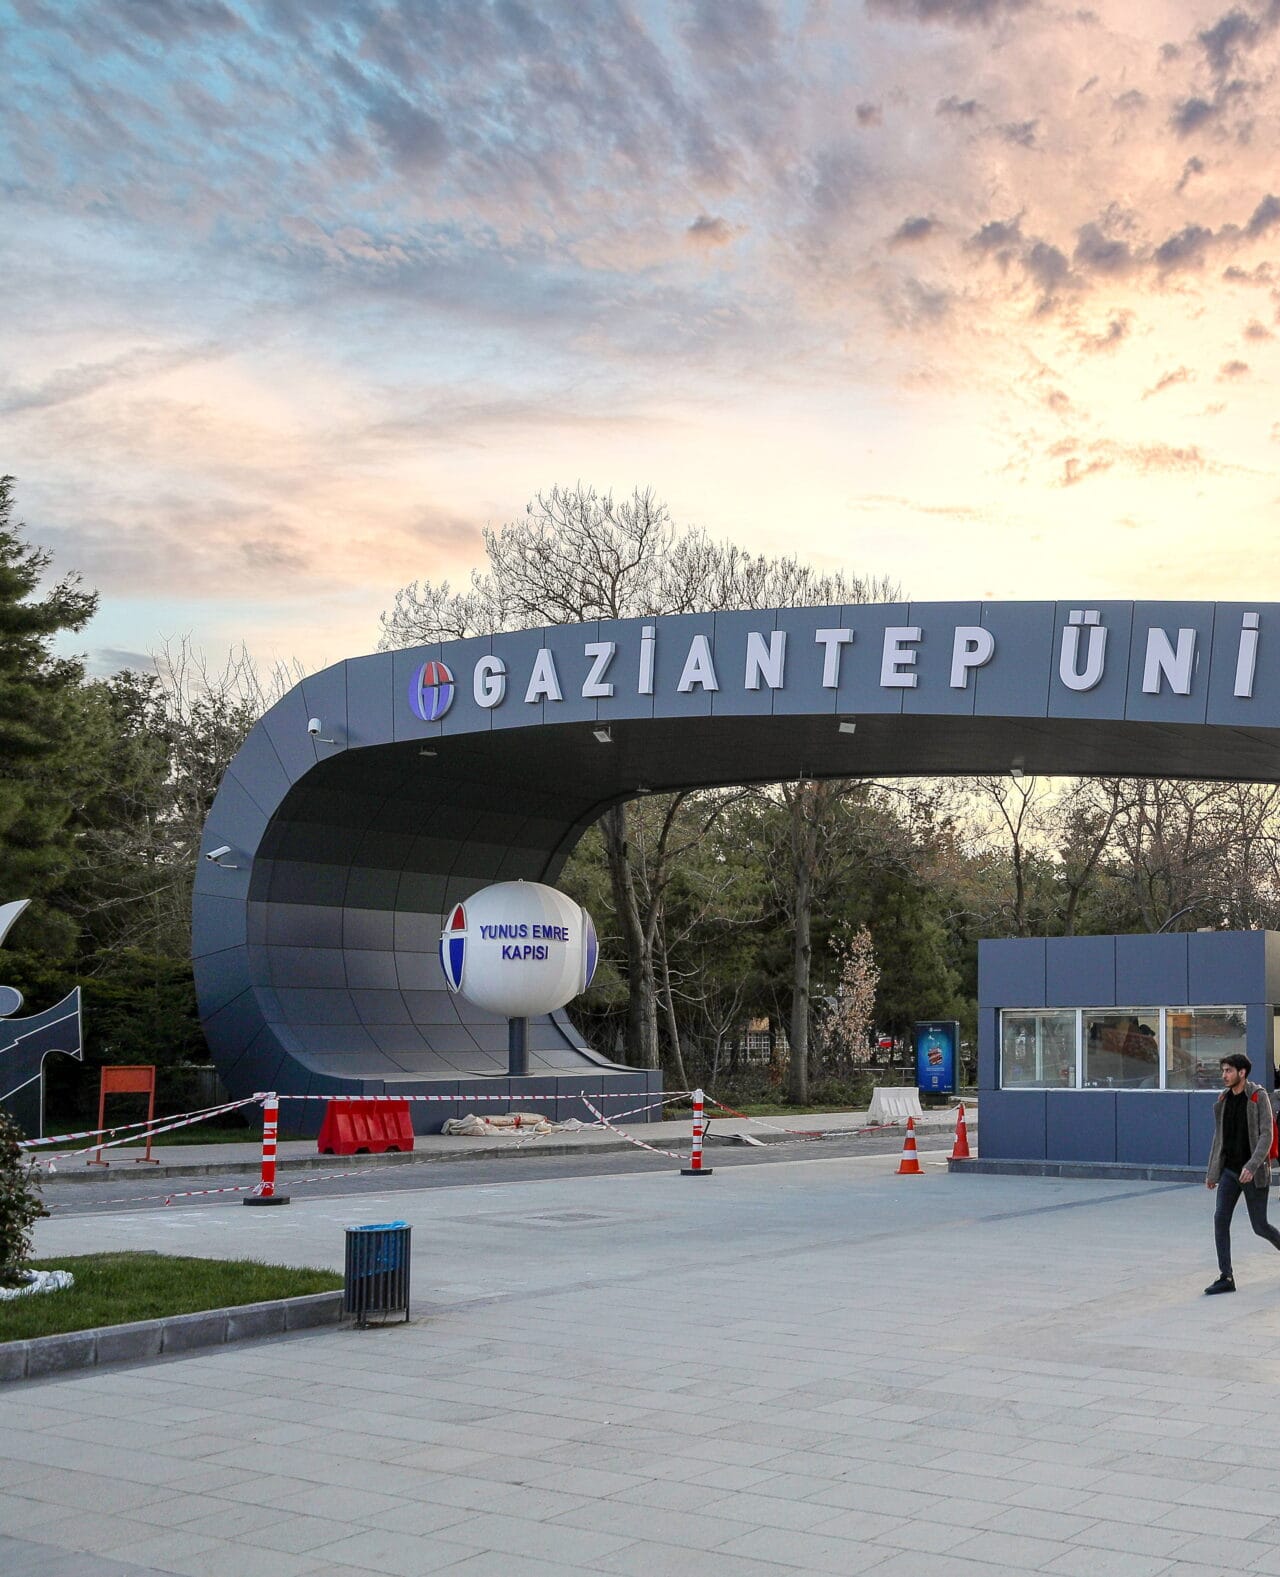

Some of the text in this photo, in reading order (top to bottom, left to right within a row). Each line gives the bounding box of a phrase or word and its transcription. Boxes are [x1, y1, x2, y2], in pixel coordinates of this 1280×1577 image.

[472, 625, 996, 708] GAZİANTEP
[479, 924, 569, 941] YUNUS EMRE
[502, 945, 549, 960] KAPISI
